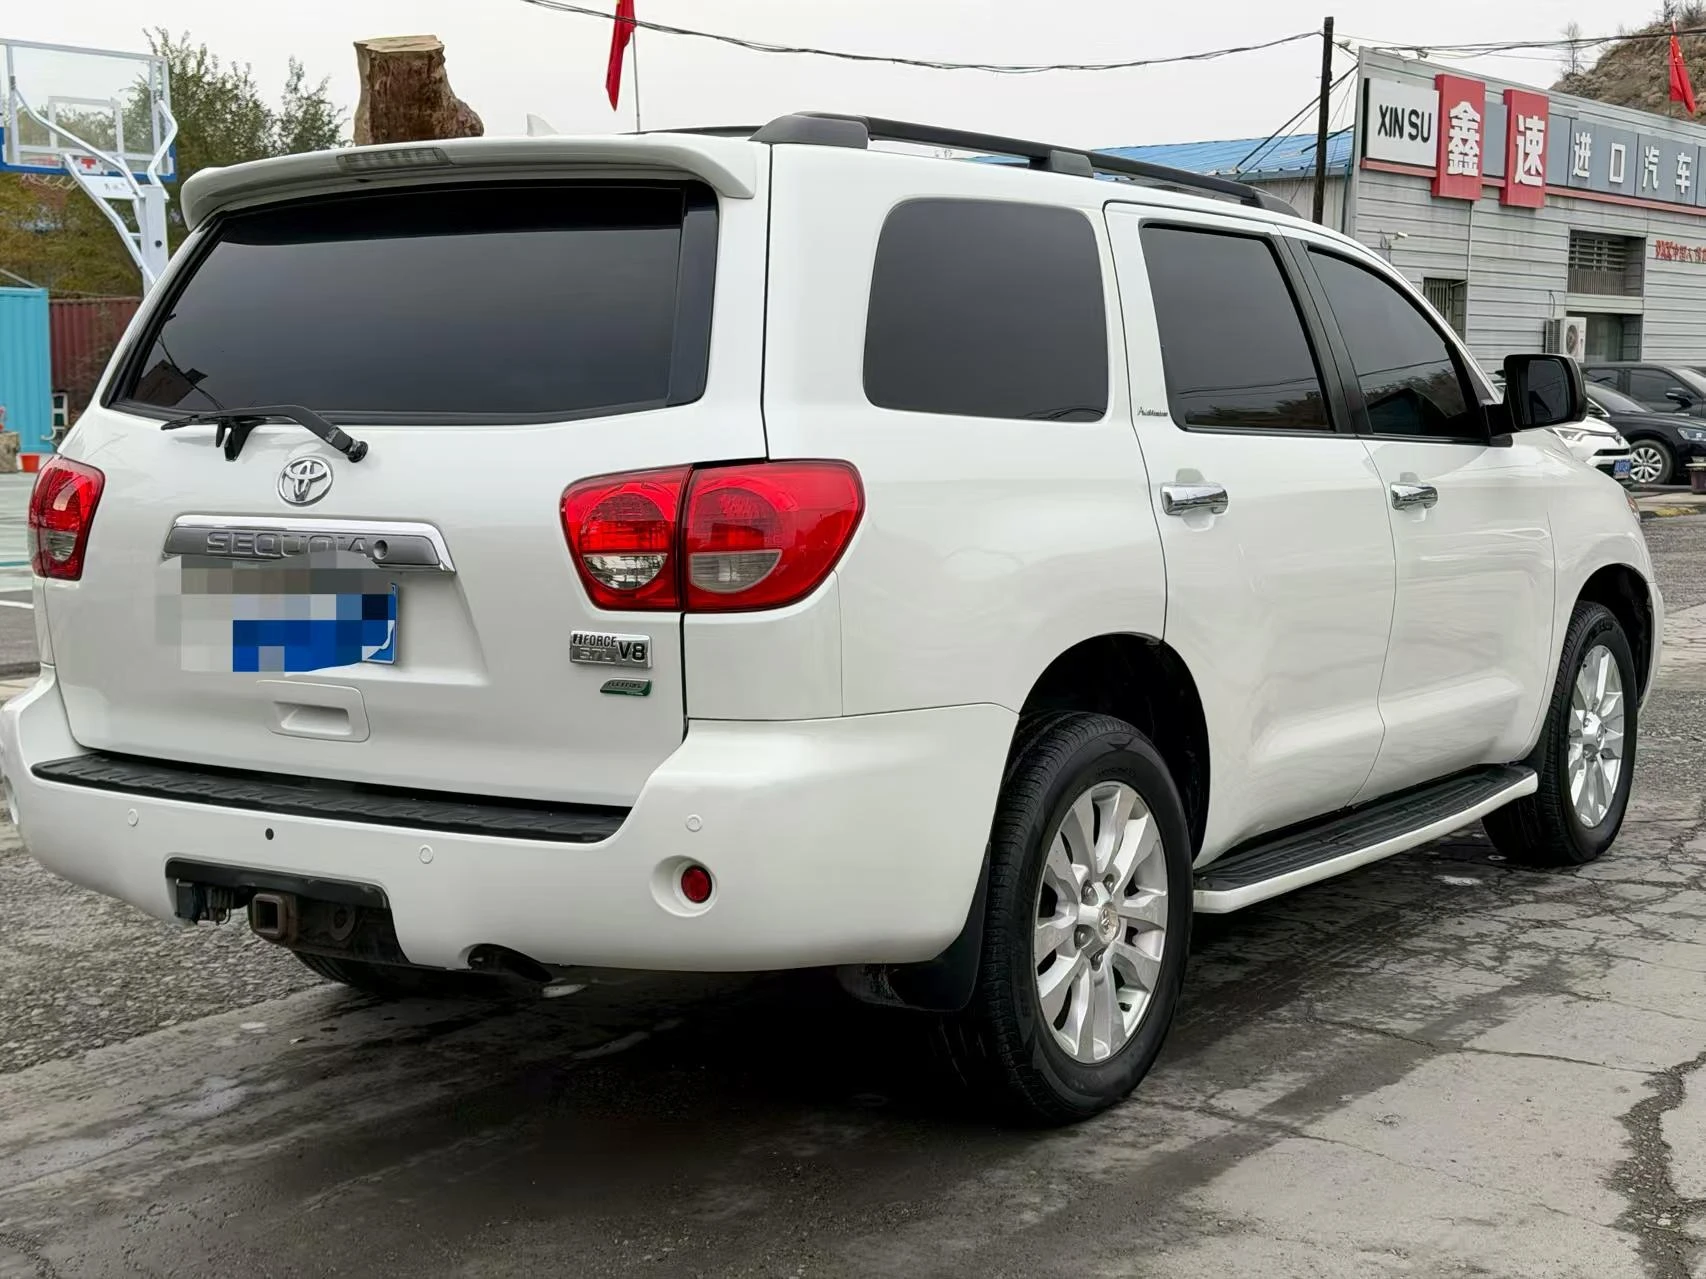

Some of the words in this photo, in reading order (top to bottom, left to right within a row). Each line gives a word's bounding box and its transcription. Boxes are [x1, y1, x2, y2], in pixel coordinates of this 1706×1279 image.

[1377, 104, 1405, 139] XIN
[1408, 109, 1432, 143] SU
[206, 531, 368, 558] SEQUOIA
[618, 641, 646, 662] V8
